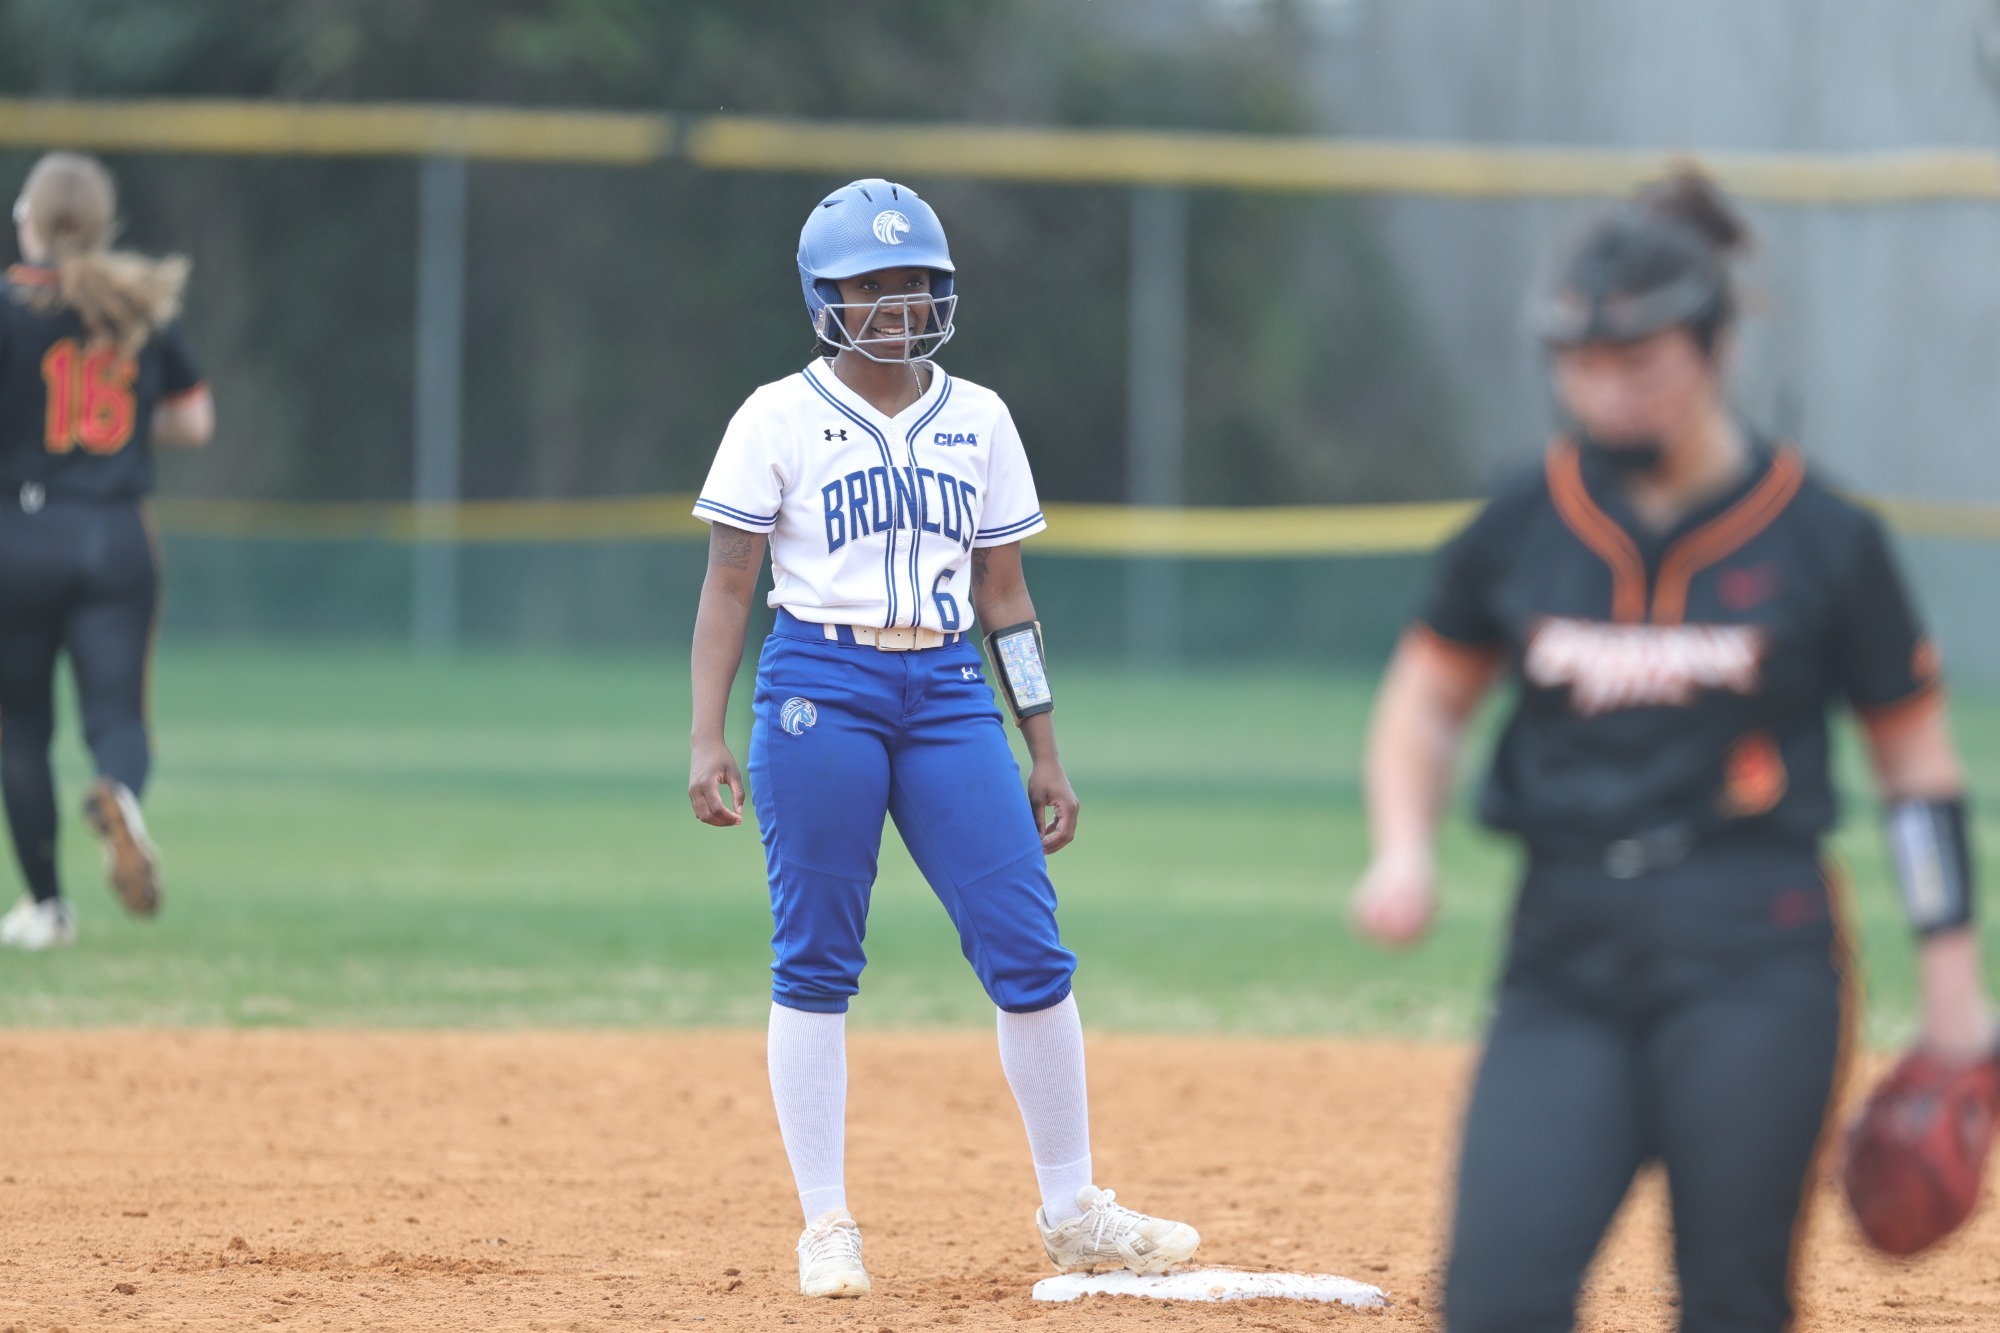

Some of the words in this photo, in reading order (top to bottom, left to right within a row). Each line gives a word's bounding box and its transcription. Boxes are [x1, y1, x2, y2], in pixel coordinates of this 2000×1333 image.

[42, 338, 138, 453] 16
[934, 432, 977, 447] CIAA
[821, 466, 977, 554] BRONCOS
[932, 568, 960, 631] 6
